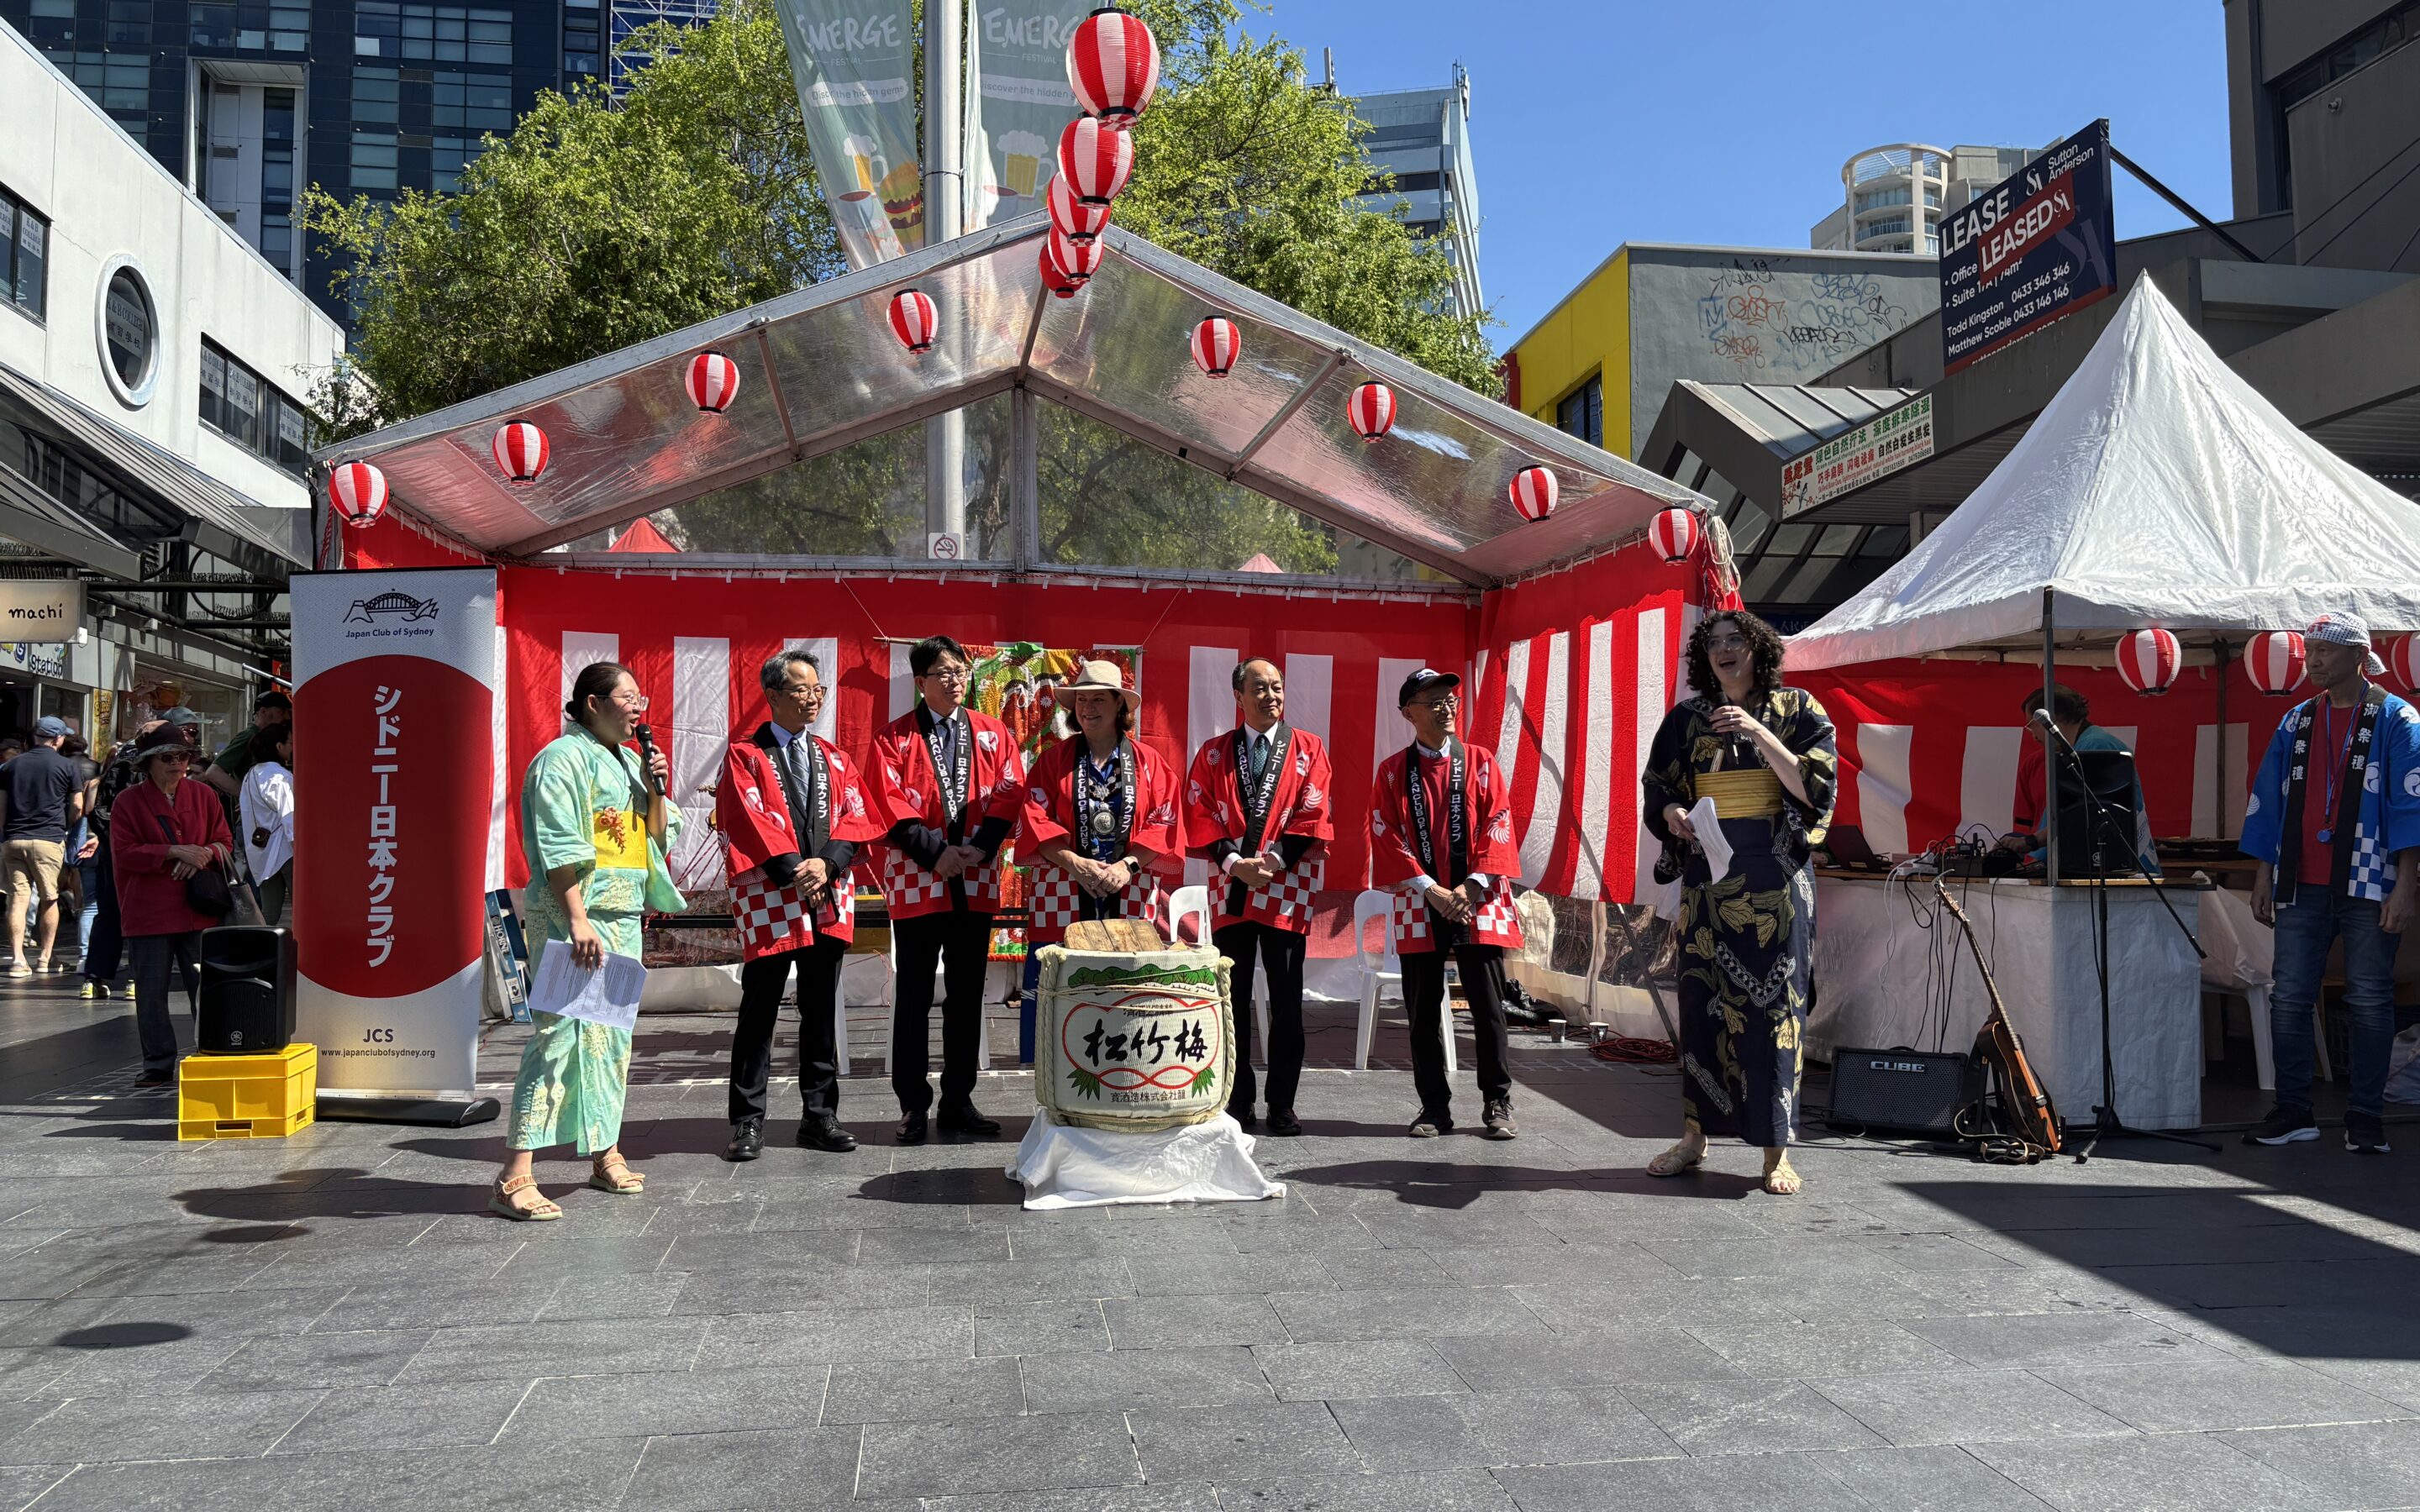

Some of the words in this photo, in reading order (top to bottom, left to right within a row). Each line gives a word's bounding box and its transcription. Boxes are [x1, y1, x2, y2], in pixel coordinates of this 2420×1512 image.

[1022, 54, 1057, 64] FESTIVAL
[836, 88, 851, 99] the
[881, 85, 904, 97] gems
[1020, 85, 1034, 95] the
[1037, 87, 1068, 98] hidden
[2049, 144, 2078, 170] Sutton
[2049, 147, 2094, 183] Anderson
[1942, 188, 2010, 258] LEASE
[1981, 199, 2053, 272] LEASED
[1950, 263, 1978, 286] Office
[1947, 315, 1967, 338] Todd
[1969, 301, 2004, 324] Kingston
[2012, 283, 2032, 303] 0433
[2033, 272, 2051, 291] 346
[2053, 261, 2070, 281] 346
[1952, 286, 1975, 307] Suite
[1948, 330, 1983, 358] Matthew
[1984, 316, 2012, 338] Scoble
[2013, 302, 2034, 323] 0433
[2036, 292, 2051, 311] 146
[2053, 283, 2070, 302] 146
[8, 603, 63, 619] machi
[345, 630, 370, 639] Japan
[372, 628, 391, 637] Club
[392, 627, 402, 636] of
[403, 627, 434, 637] Sydney
[29, 654, 64, 678] Station
[959, 722, 968, 754] シドニー
[935, 755, 949, 777] CLUB
[1271, 740, 1286, 771] シドニー
[942, 777, 951, 790] OF
[957, 758, 967, 803] 日本クラブ
[1452, 758, 1462, 790] シドニー
[817, 773, 829, 819] 日本クラブ
[946, 790, 958, 823] SYDNEY
[1120, 785, 1135, 833] 日本クラブ
[1255, 773, 1276, 817] 日本クラブ
[367, 685, 402, 968] シドニー日本クラブ
[1079, 814, 1089, 850] SYDNEY
[1451, 794, 1461, 842] 日本クラブ
[1420, 830, 1432, 864] SYDNEY
[363, 1028, 394, 1043] JCS
[1083, 1018, 1207, 1067] 松竹梅
[321, 1048, 435, 1058] www.japanclubofsydney.org
[1870, 1061, 1925, 1073] CUBE
